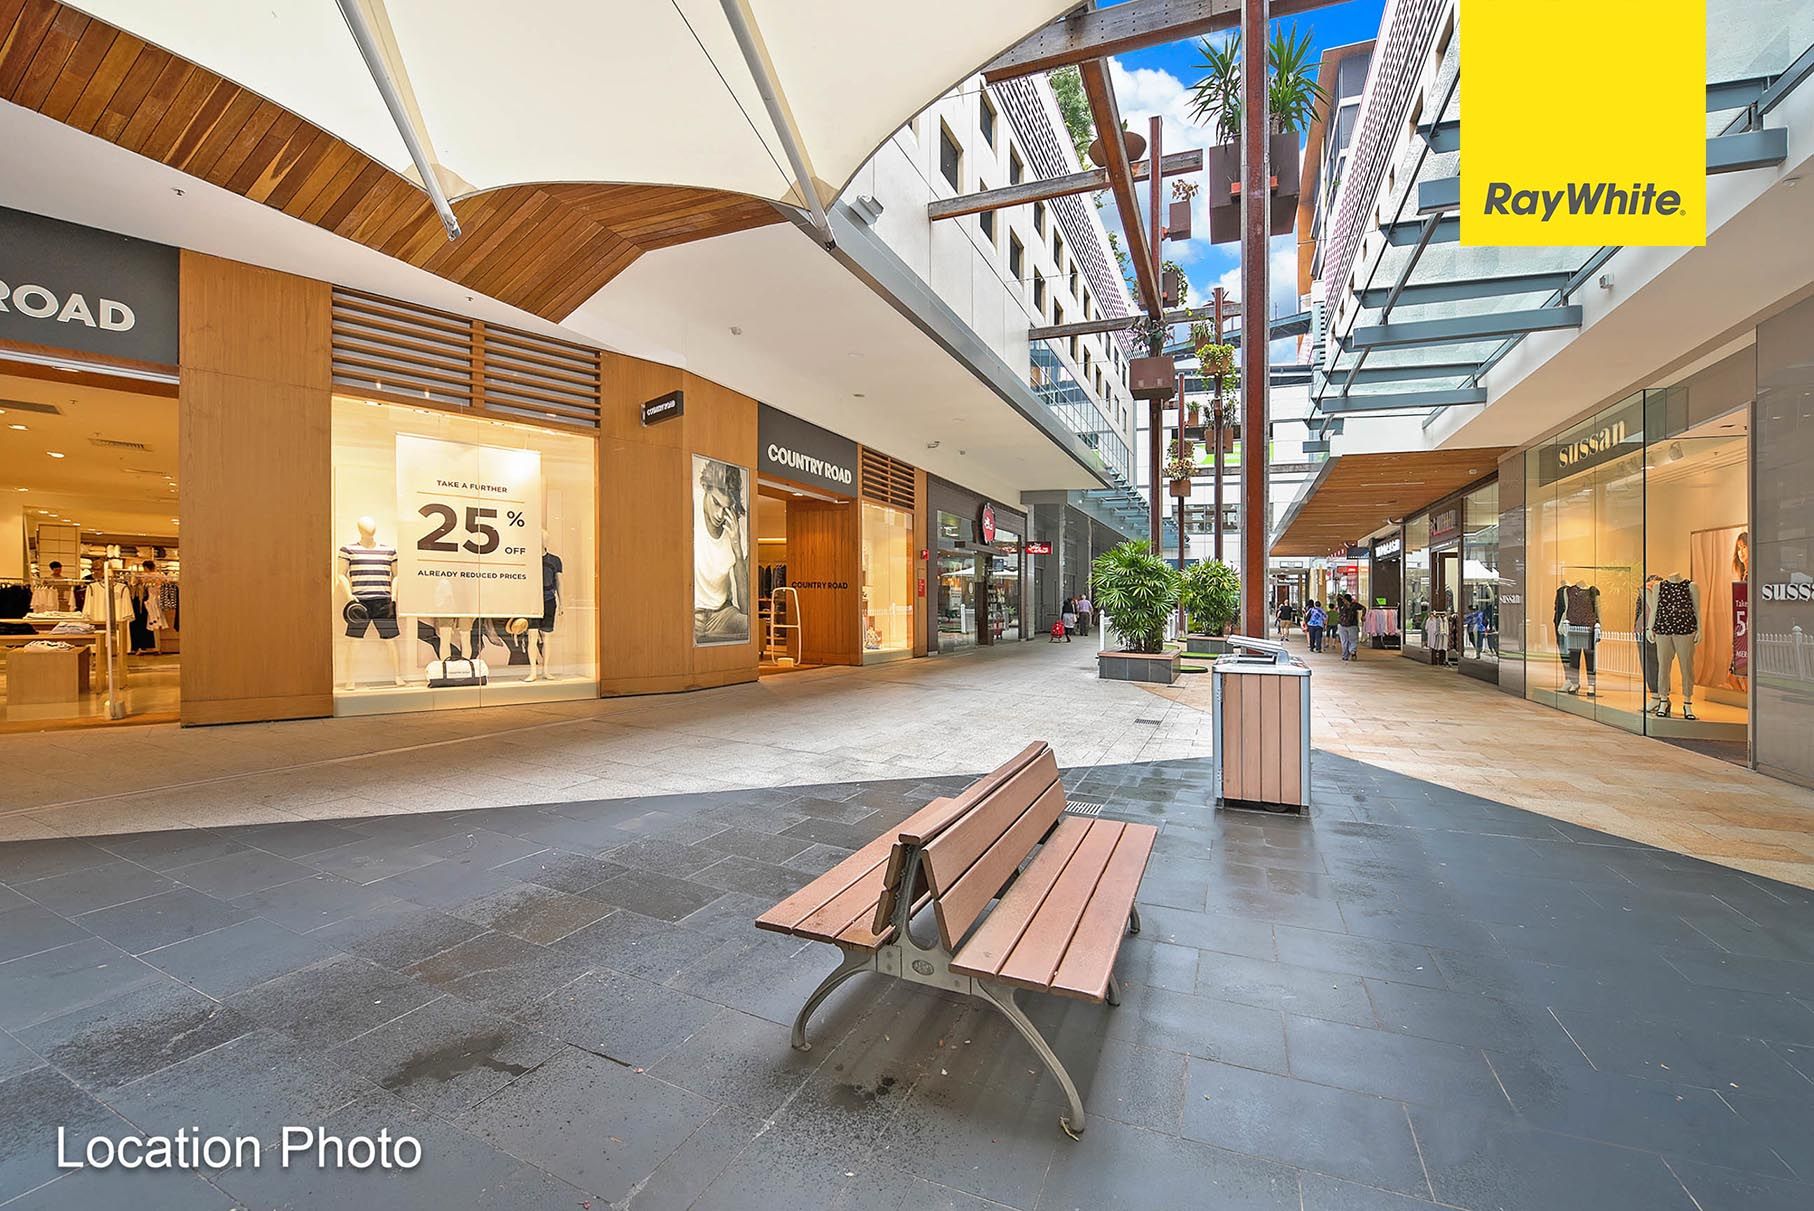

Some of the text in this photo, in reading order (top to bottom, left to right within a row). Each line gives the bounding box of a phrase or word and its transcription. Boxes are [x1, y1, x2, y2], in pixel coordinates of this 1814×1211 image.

[1559, 420, 1625, 468] sussan
[767, 444, 852, 484] COUNTRY ROAD
[437, 480, 459, 488] TAKE
[470, 483, 508, 493] FURTHER
[504, 546, 526, 555] OFF
[417, 570, 458, 578] ALREADY
[460, 571, 498, 579] REDUCED
[791, 581, 827, 589] COUNTRY
[1761, 583, 1814, 601] suss
[1736, 611, 1748, 637] 5
